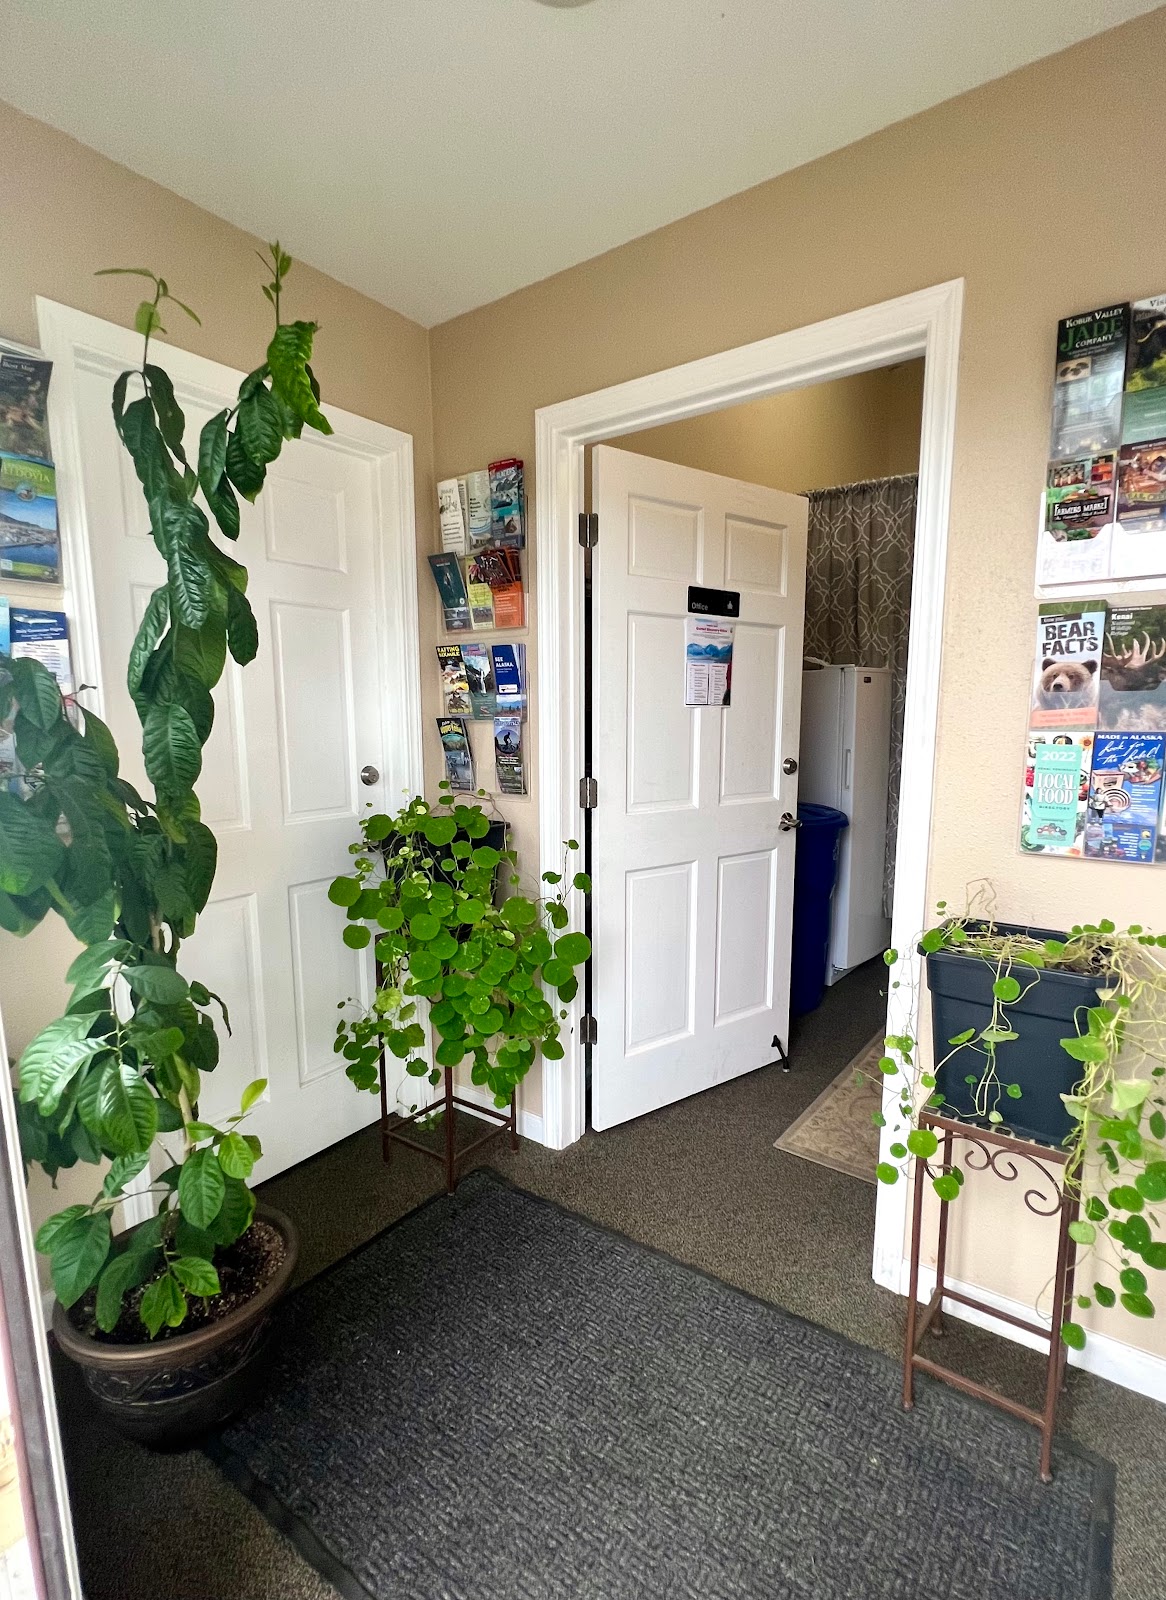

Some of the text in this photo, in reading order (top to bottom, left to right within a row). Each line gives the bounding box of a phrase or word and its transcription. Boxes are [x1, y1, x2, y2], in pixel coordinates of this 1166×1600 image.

[1060, 316, 1123, 352] JADE
[1075, 333, 1113, 348] COMPANY
[1083, 497, 1109, 512] MARKET
[691, 602, 709, 611] Office
[1045, 621, 1095, 641] BEAR
[1042, 637, 1098, 657] FACTS
[1040, 751, 1077, 762] 2022
[1037, 772, 1077, 790] LOCAL
[1037, 788, 1073, 805] FOOD
